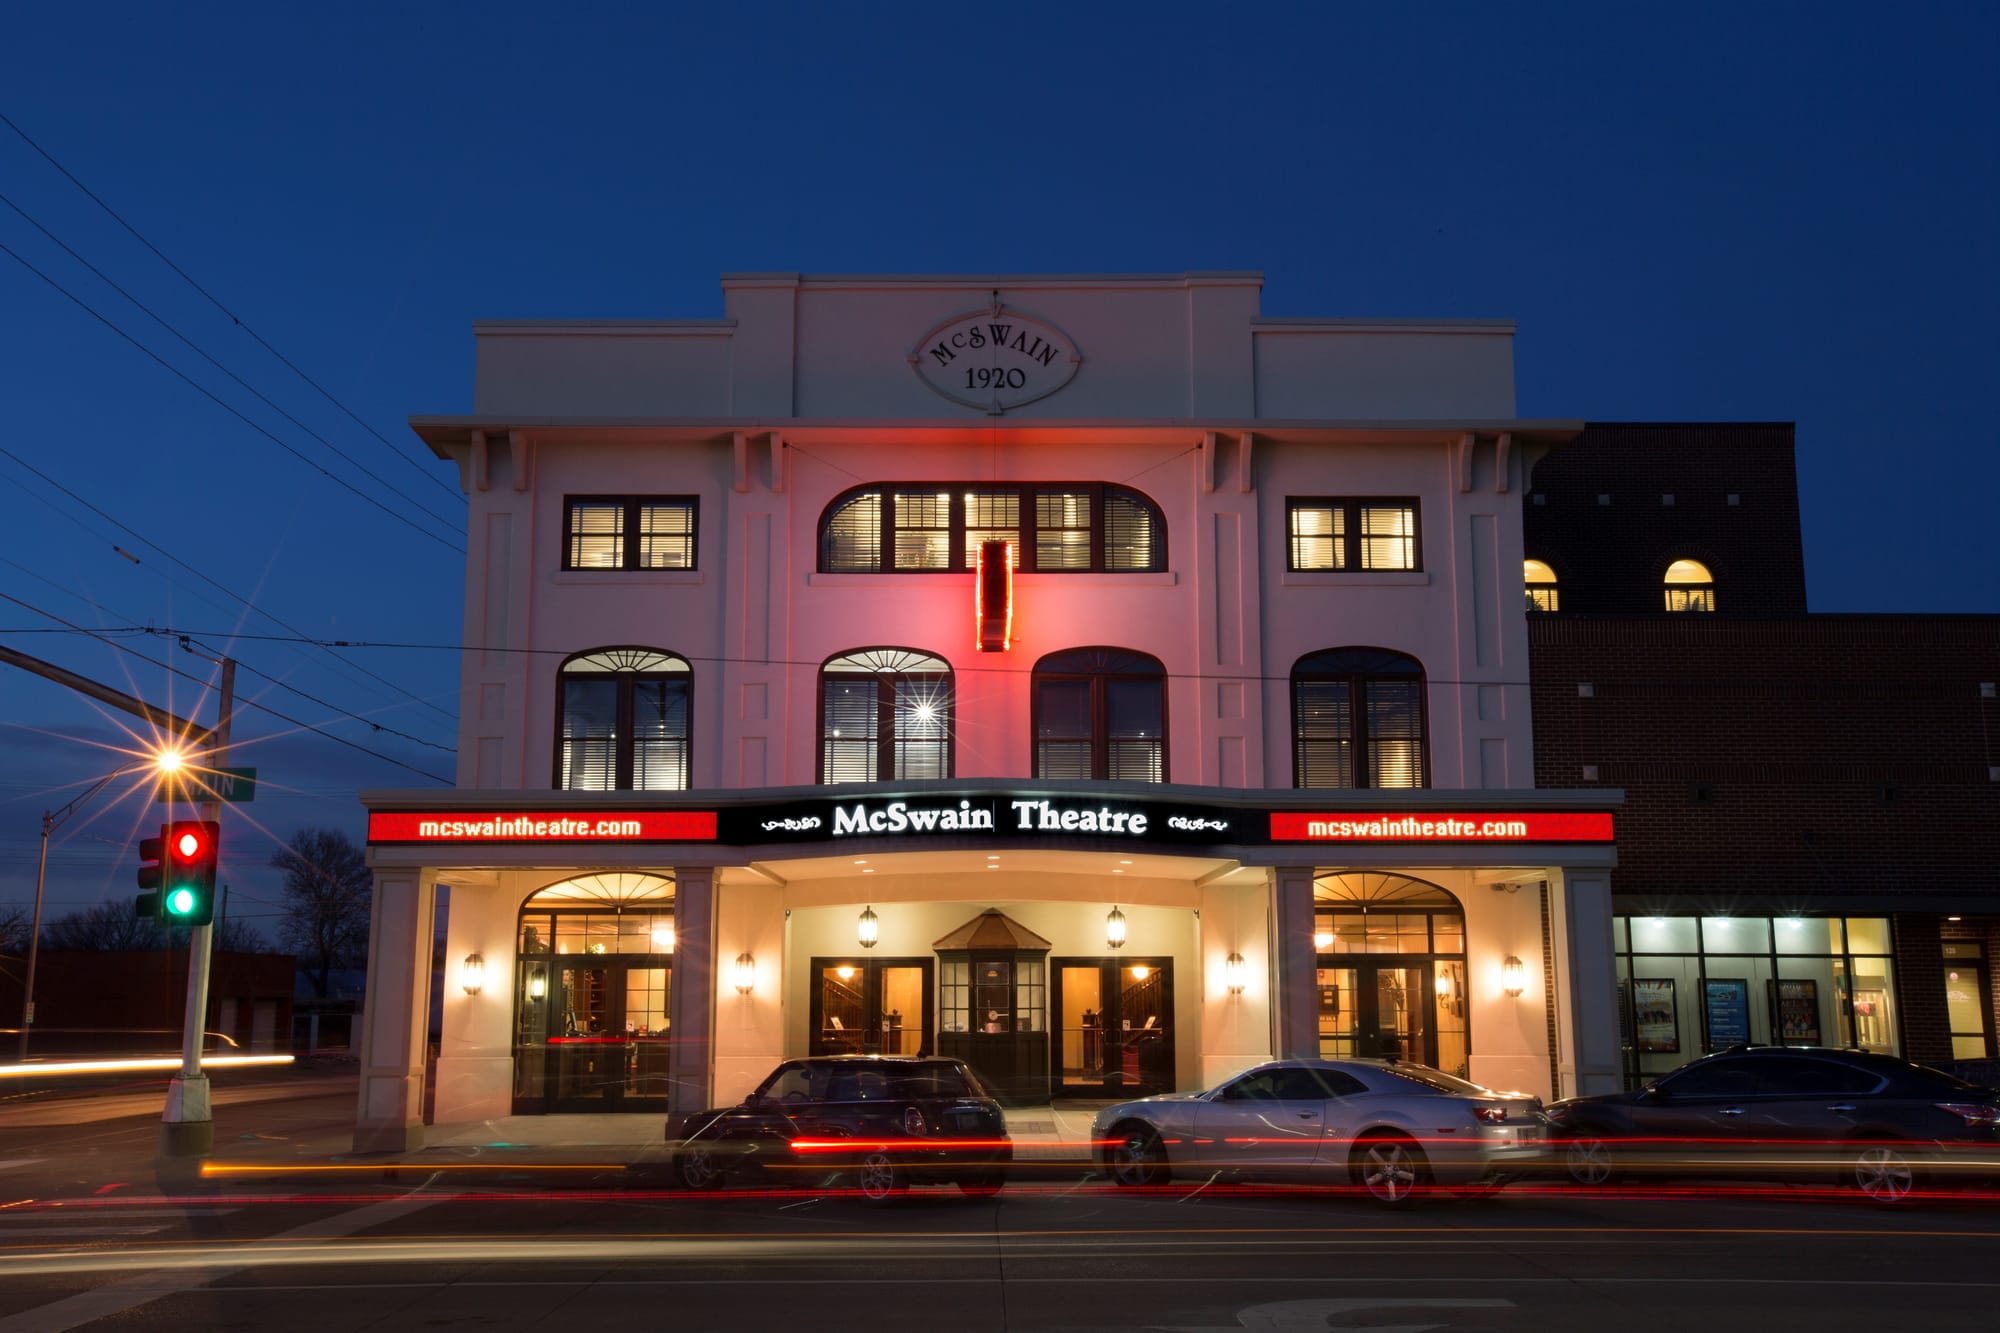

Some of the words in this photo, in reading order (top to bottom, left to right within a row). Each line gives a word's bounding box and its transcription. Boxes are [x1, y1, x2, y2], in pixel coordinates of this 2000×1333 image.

[965, 367, 1026, 389] 1920
[419, 817, 641, 837] mcswaintheatre.com
[832, 800, 994, 835] McSwain
[1011, 800, 1148, 834] Theatre
[1307, 817, 1527, 837] mcswaintheatre.com
